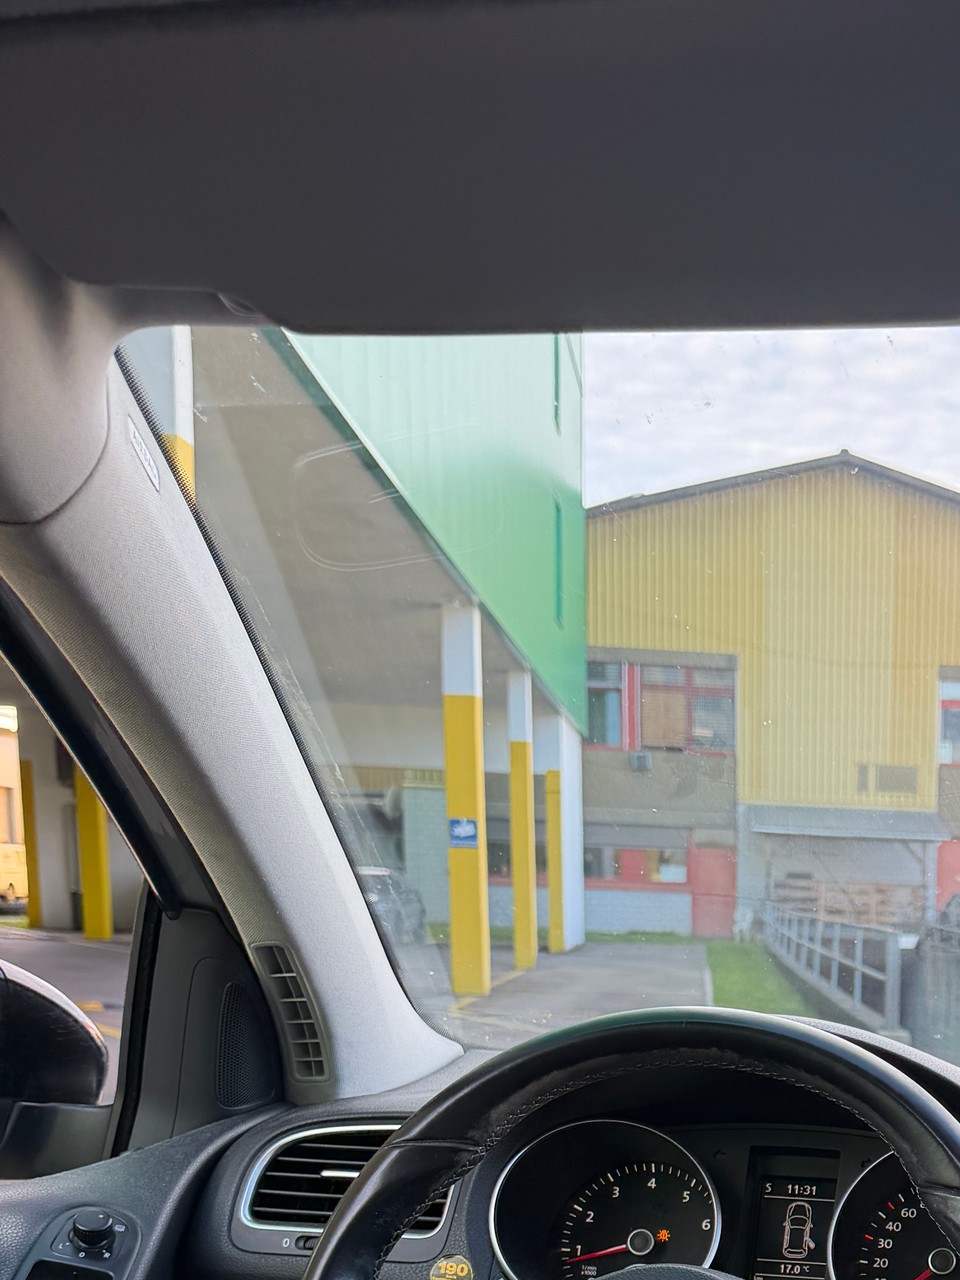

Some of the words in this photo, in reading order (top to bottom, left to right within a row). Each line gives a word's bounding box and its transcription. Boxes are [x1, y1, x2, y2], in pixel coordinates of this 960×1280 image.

[647, 1178, 656, 1189] 4
[765, 1183, 772, 1193] S
[787, 1184, 817, 1195] 11:31
[612, 1186, 620, 1198] 3
[682, 1191, 690, 1202] 5
[585, 1211, 594, 1223] 2
[900, 1208, 917, 1218] 60
[702, 1219, 711, 1231] 6
[885, 1221, 902, 1232] 40
[877, 1239, 893, 1249] 30
[575, 1245, 582, 1256] 1
[873, 1258, 889, 1268] 20
[438, 1262, 469, 1277] 190
[780, 1264, 800, 1274] 17.0
